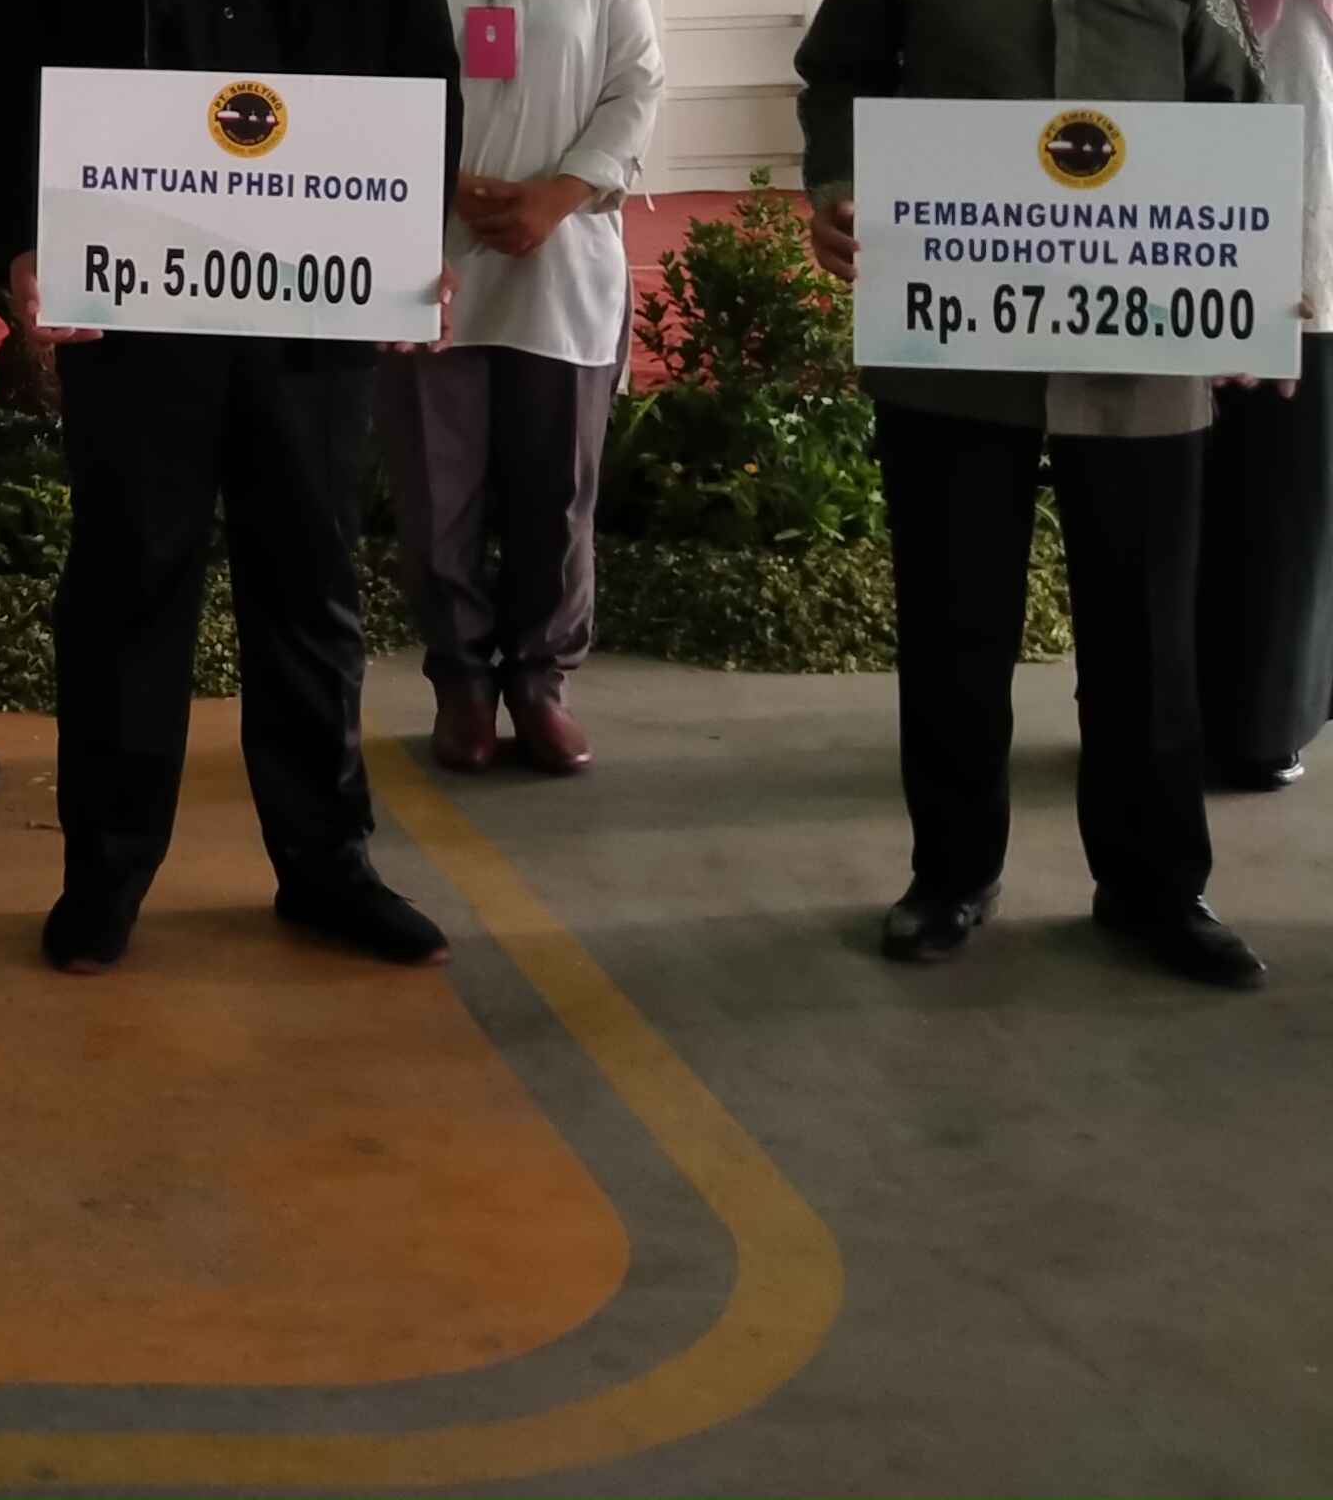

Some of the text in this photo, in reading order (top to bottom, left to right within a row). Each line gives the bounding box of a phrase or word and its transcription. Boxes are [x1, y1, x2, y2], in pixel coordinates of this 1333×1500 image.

[82, 166, 408, 202] BANTUAN PHBI ROOMO
[895, 202, 1269, 231] PEMBANGUNAN MASJID
[924, 238, 1238, 267] ROUDHOTUL ABROR
[85, 245, 371, 305] Rp. 5.000.000
[907, 282, 1254, 344] Rp. 67.328.000
